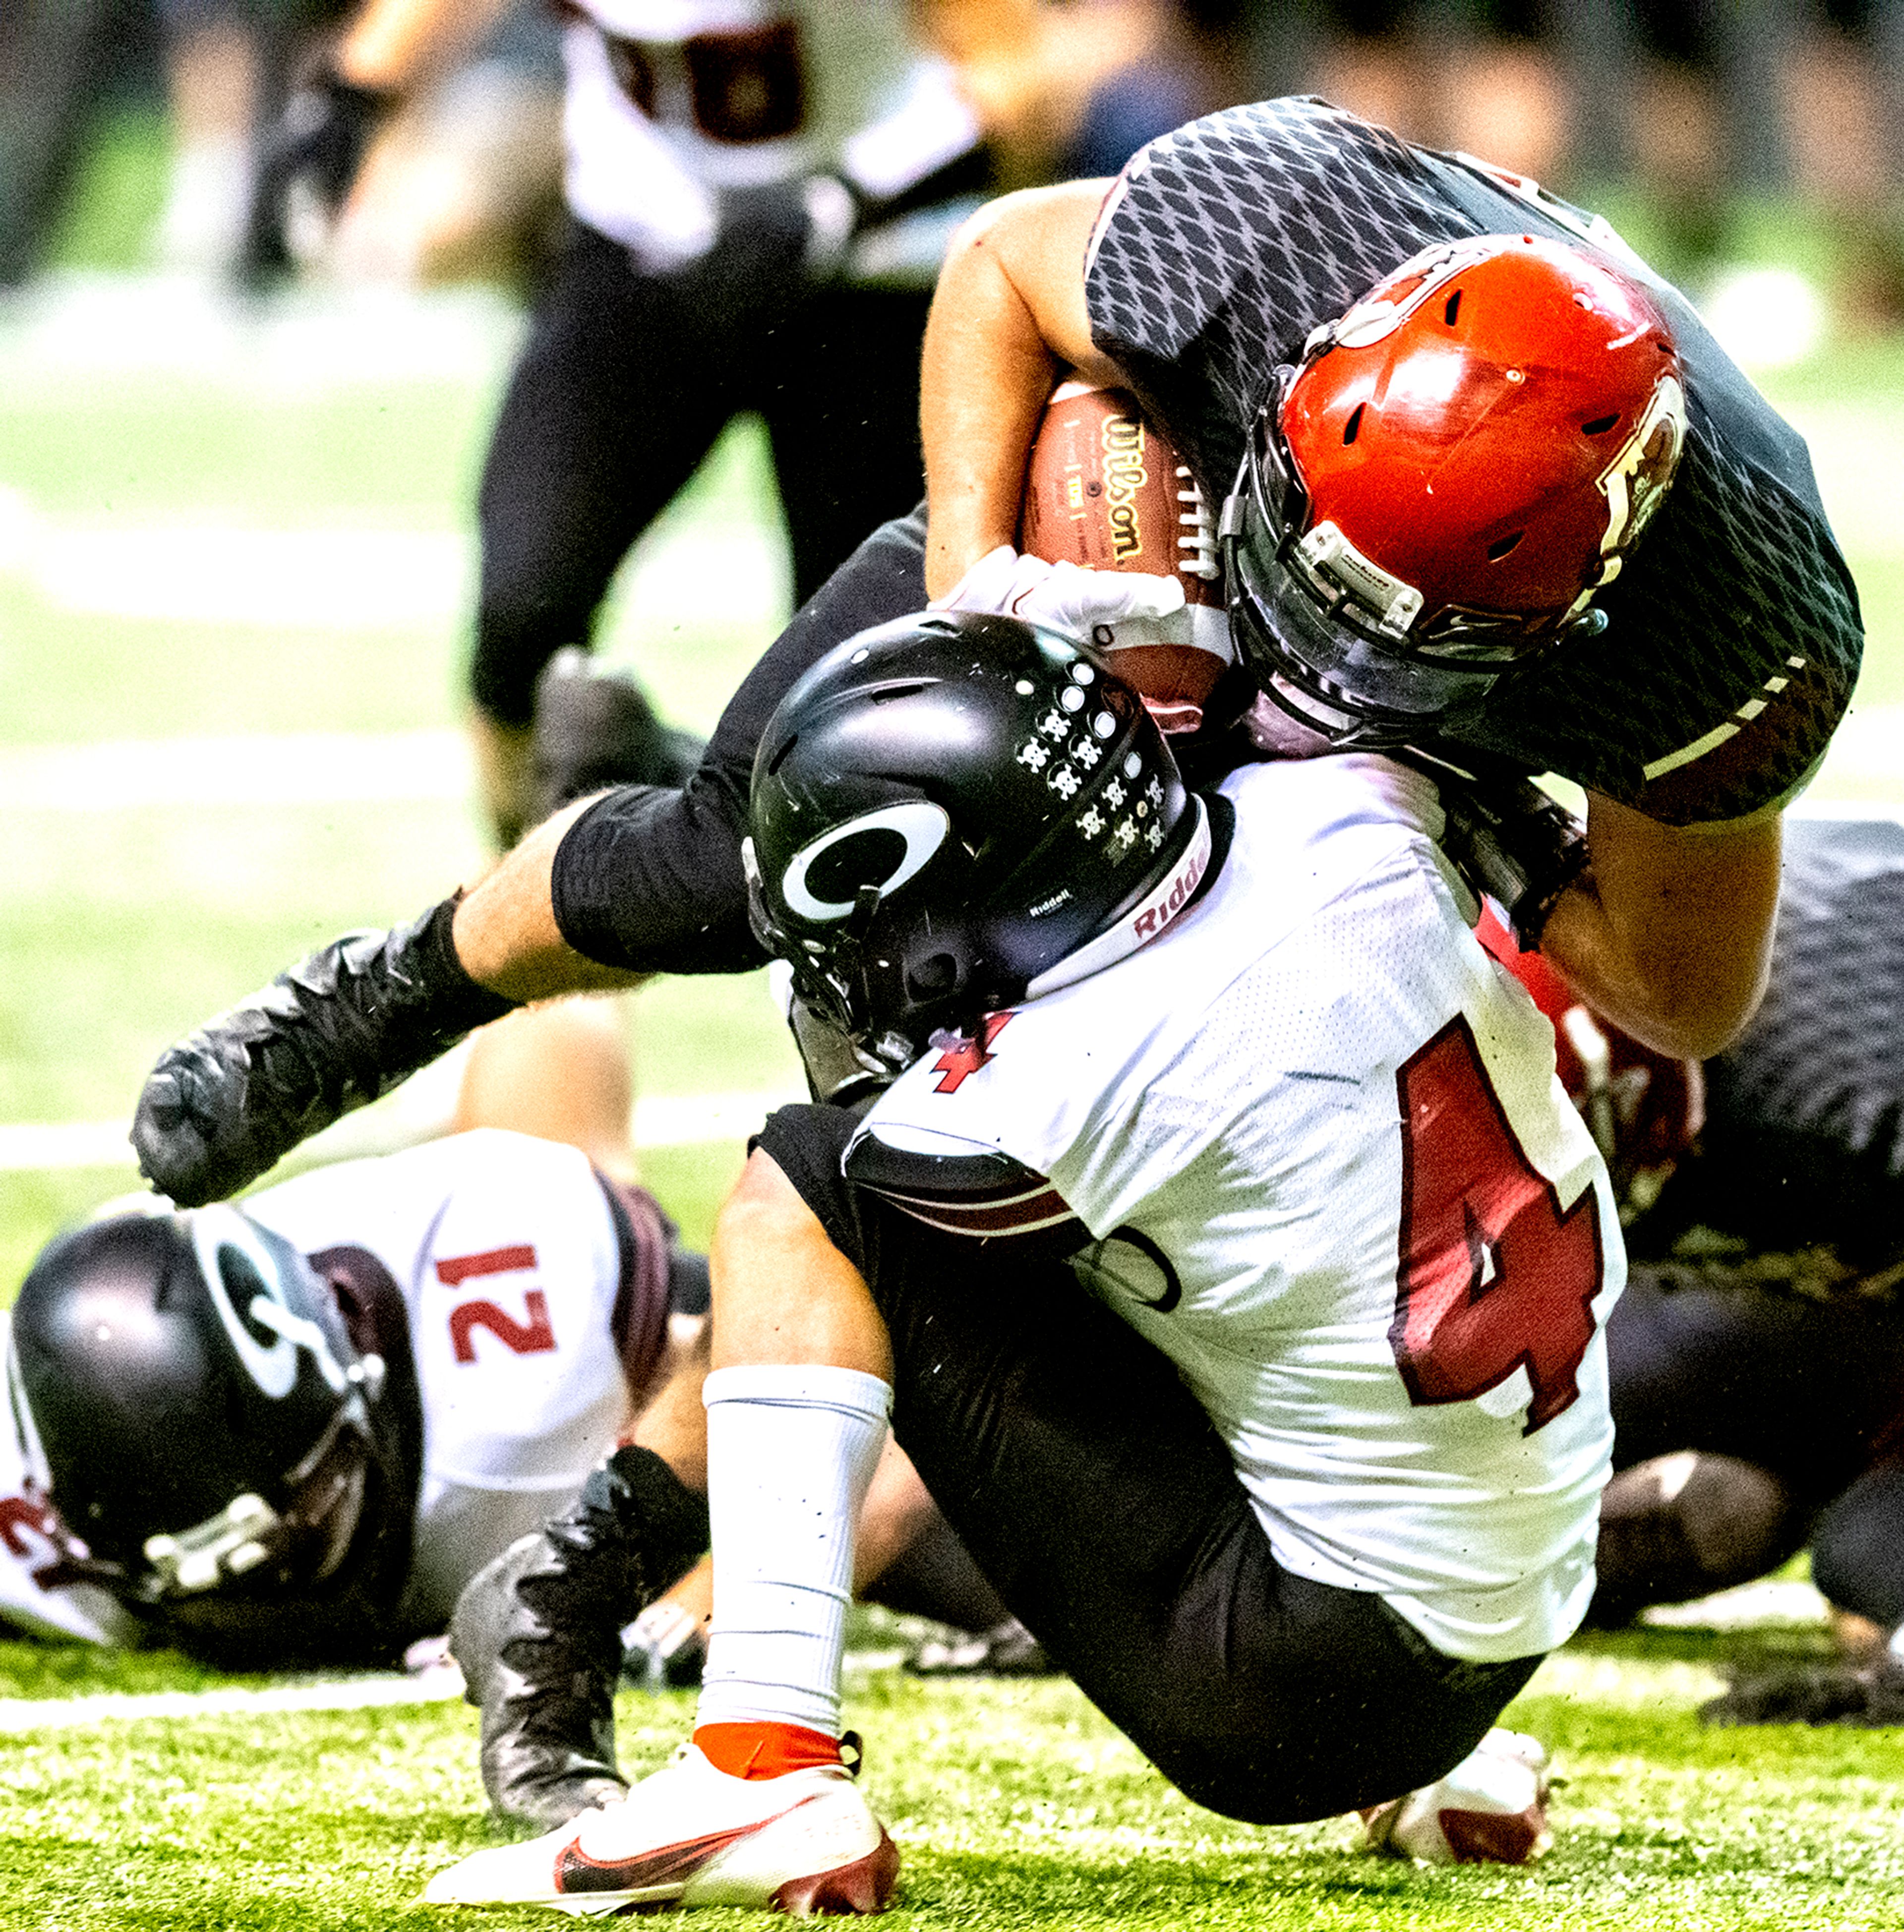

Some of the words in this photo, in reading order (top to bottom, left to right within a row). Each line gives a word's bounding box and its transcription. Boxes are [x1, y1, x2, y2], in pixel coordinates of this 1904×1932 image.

[1102, 414, 1148, 564] Wilson
[1029, 889, 1070, 917] Riddell
[929, 1010, 1022, 1095] 4
[1387, 1010, 1606, 1439] 4
[435, 1244, 557, 1365] 21
